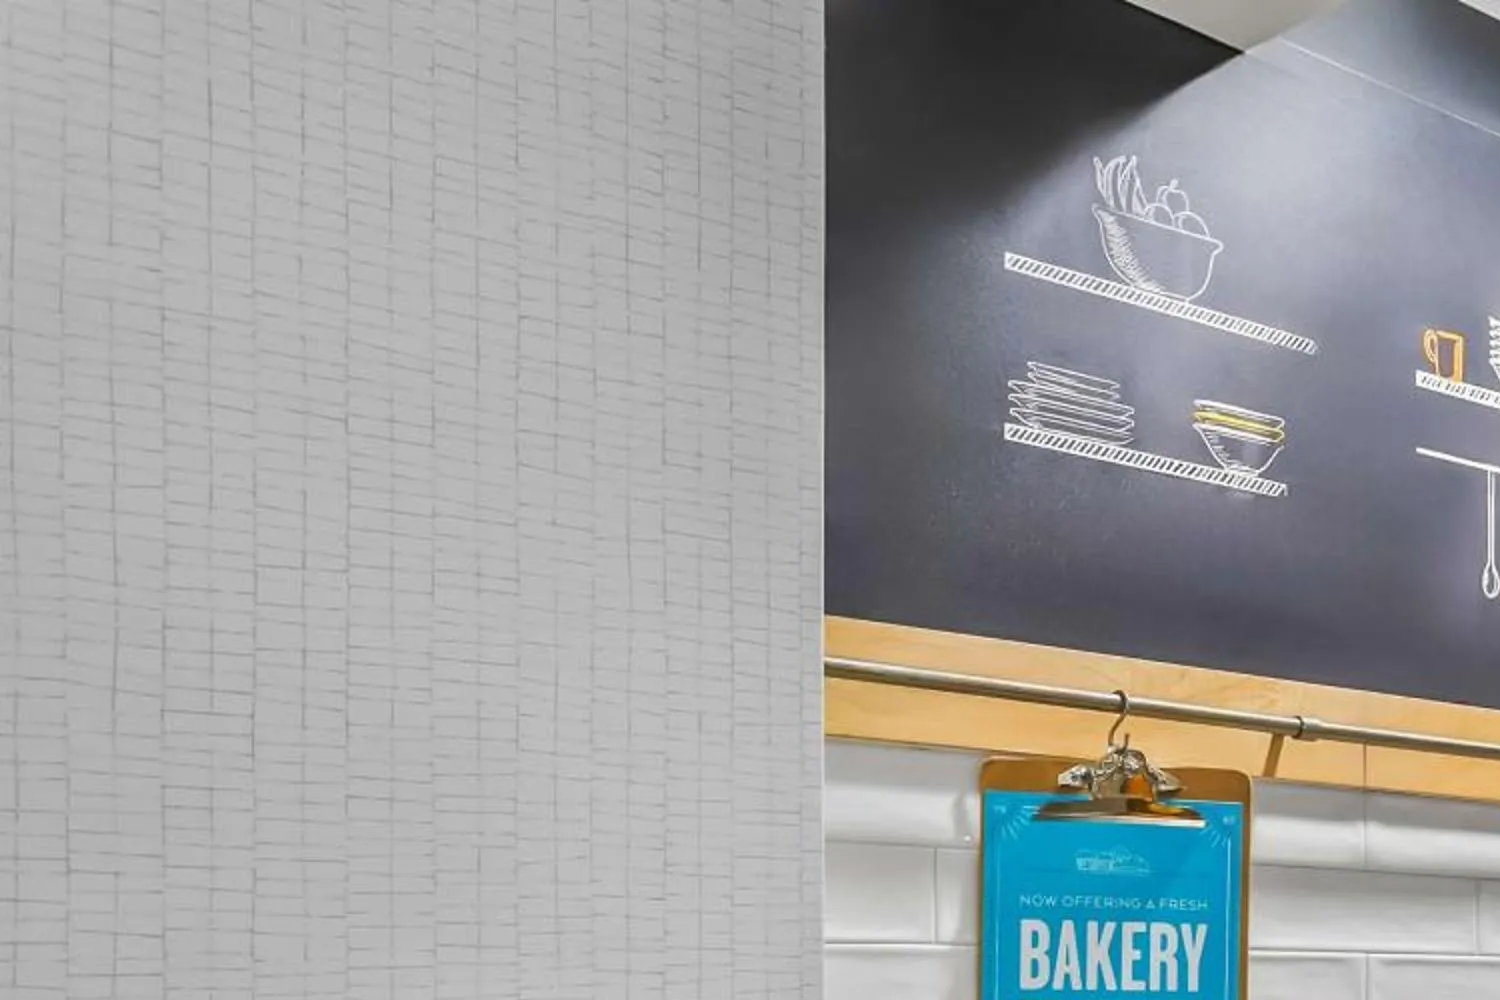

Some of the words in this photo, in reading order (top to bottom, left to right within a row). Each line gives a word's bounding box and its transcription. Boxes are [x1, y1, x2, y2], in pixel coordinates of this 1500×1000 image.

[1019, 894, 1058, 907] NOW
[1061, 895, 1142, 909] OFFERING
[1145, 898, 1156, 909] A
[1159, 897, 1208, 911] FRESH
[1019, 918, 1208, 993] BAKERY
